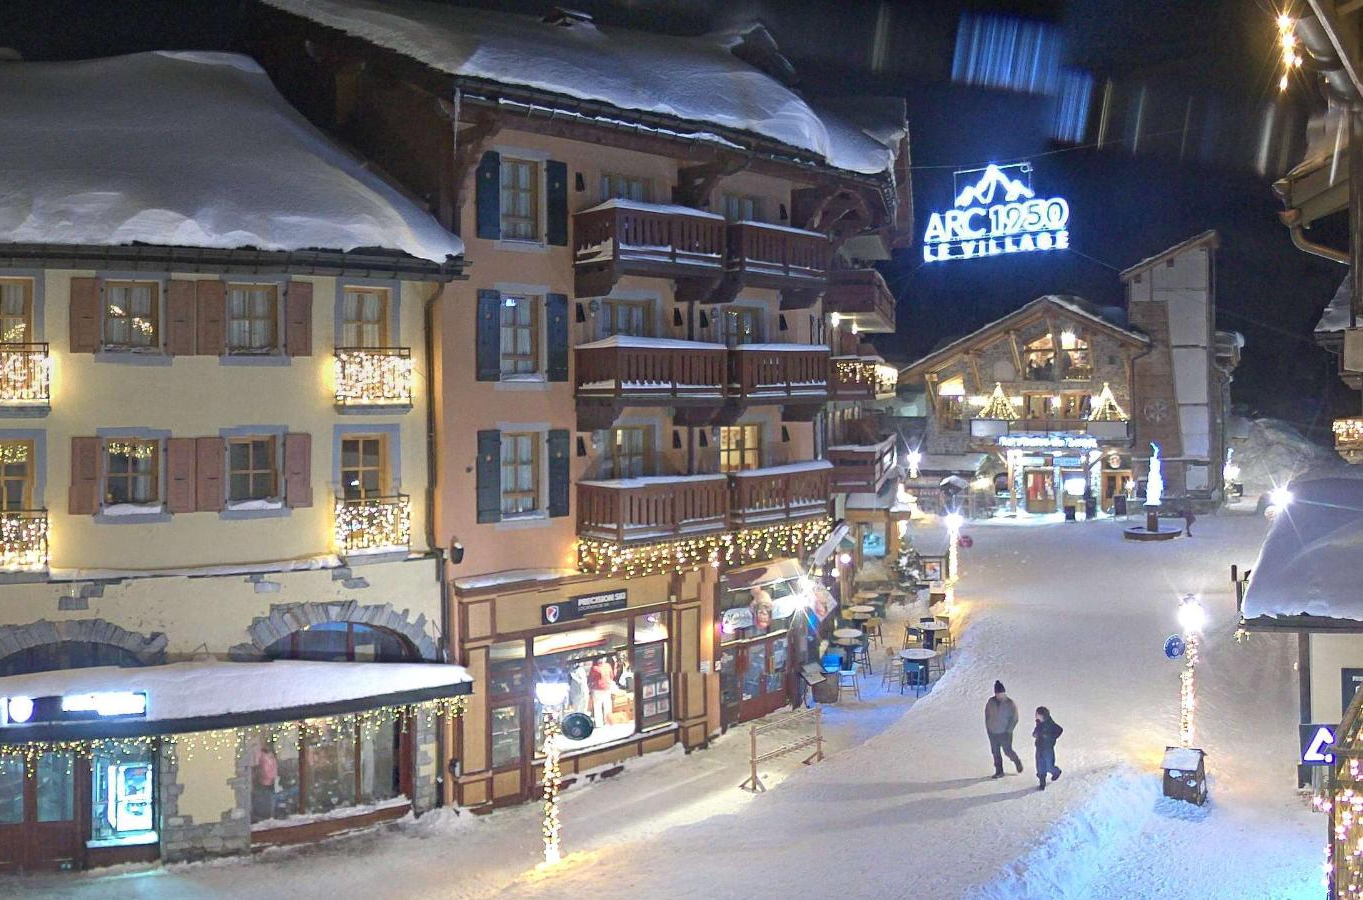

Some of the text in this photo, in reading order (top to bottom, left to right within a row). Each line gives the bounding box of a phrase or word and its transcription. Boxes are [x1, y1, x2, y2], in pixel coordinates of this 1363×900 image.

[924, 198, 1069, 243] ARC 1950
[924, 231, 1069, 262] LE VILLAGE
